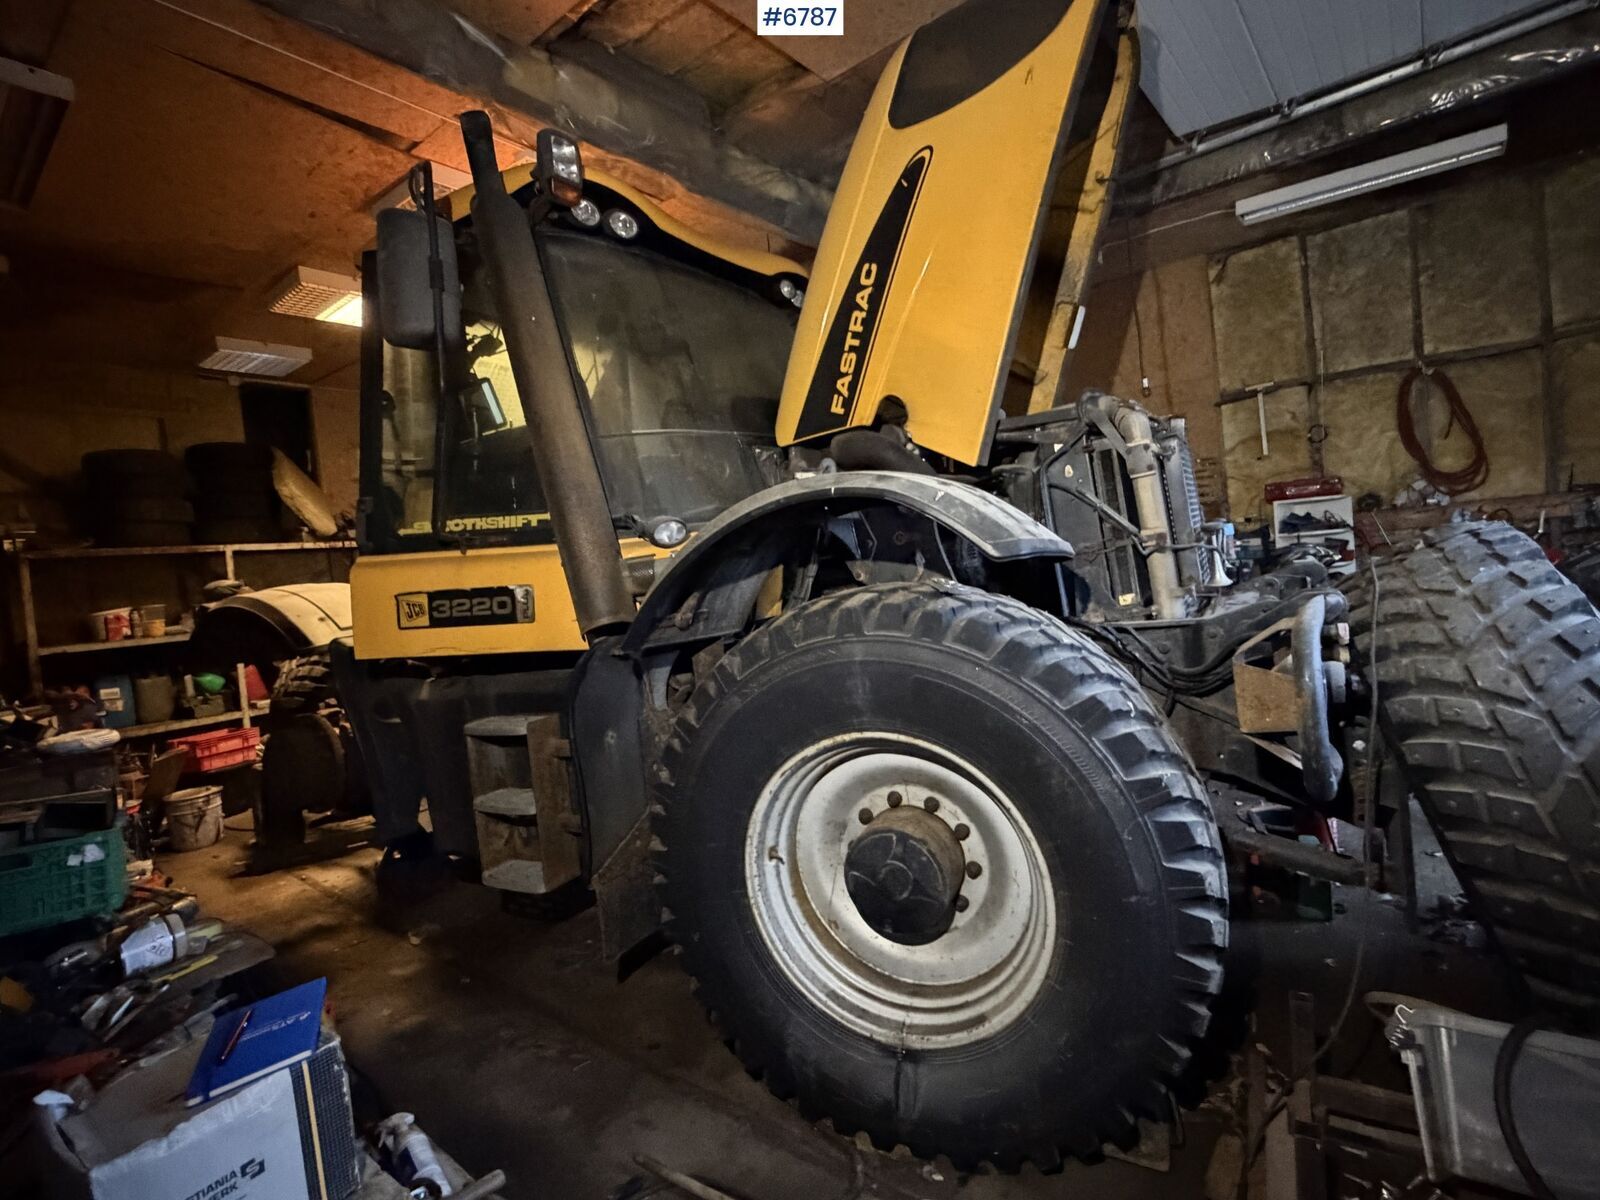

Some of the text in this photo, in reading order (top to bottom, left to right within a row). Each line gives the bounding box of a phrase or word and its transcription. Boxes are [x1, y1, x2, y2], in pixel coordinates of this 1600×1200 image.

[830, 262, 878, 415] FASTRAC
[413, 513, 549, 533] SOTHSHIFT
[406, 602, 425, 619] JCB
[432, 596, 512, 618] 3220
